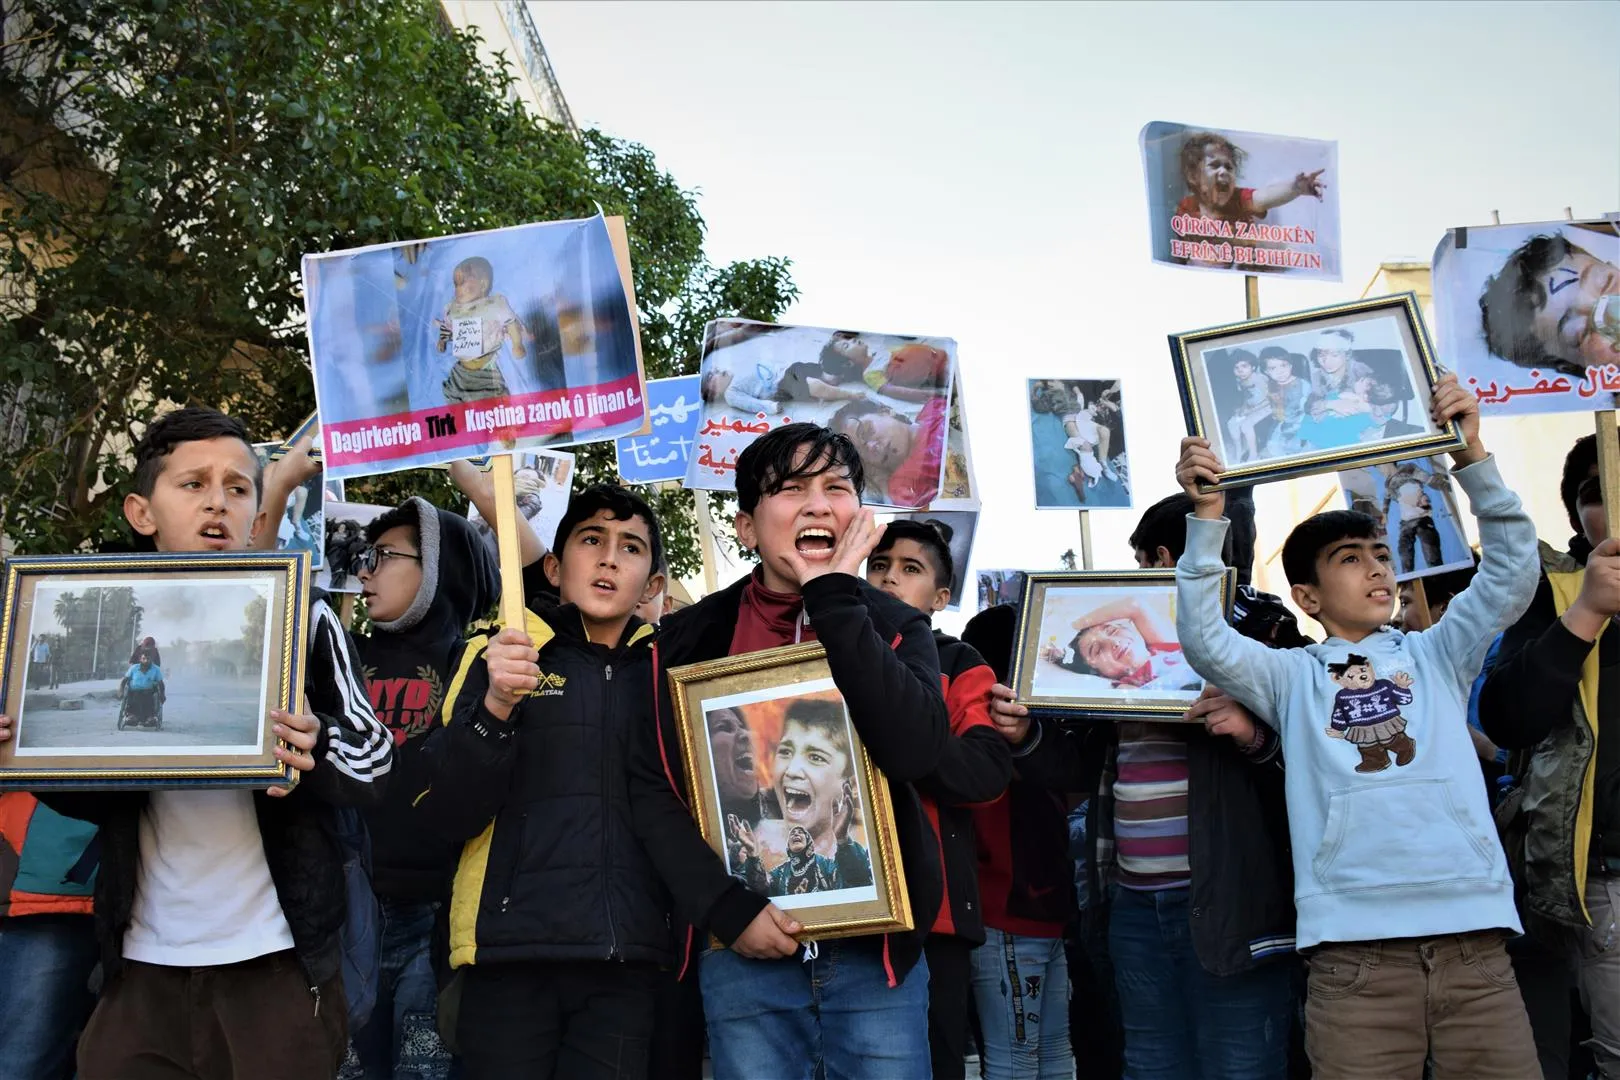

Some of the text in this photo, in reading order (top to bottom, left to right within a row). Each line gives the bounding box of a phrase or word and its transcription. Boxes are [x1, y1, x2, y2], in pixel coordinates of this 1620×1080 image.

[1171, 213, 1315, 244] QÎRÎNA ZAROKÊN
[1171, 239, 1233, 263] EFRÎNÊ
[1234, 246, 1254, 264] BI
[330, 421, 422, 454] Dagirkeriya
[425, 413, 457, 439] Tirk
[464, 404, 526, 433] Kuştina
[528, 396, 572, 423] zarok
[573, 393, 586, 417] û
[586, 387, 626, 419] jinan
[700, 412, 770, 435] ضمير
